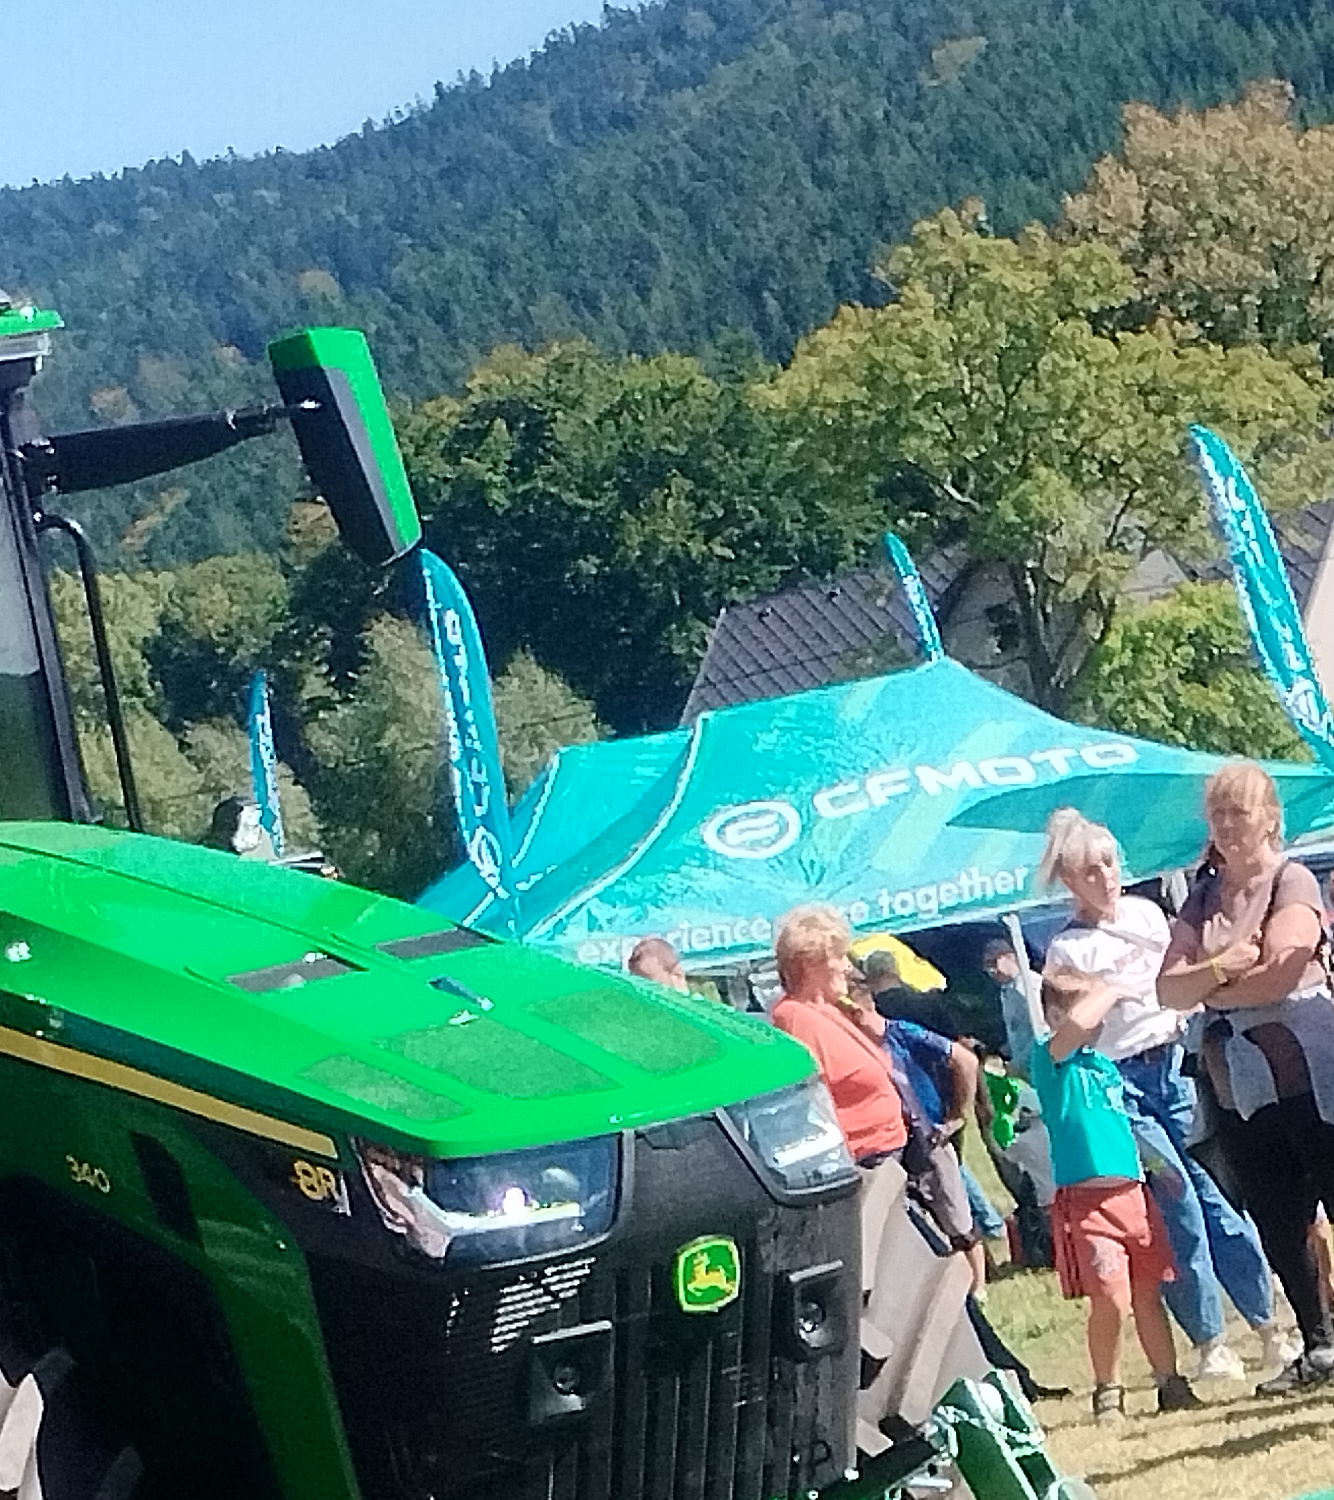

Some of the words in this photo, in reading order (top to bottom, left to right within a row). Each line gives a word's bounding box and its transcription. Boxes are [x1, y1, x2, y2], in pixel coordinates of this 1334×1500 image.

[813, 743, 1140, 820] CFMOTO
[577, 917, 772, 971] exprience
[878, 866, 1029, 919] together
[66, 1154, 111, 1193] 340
